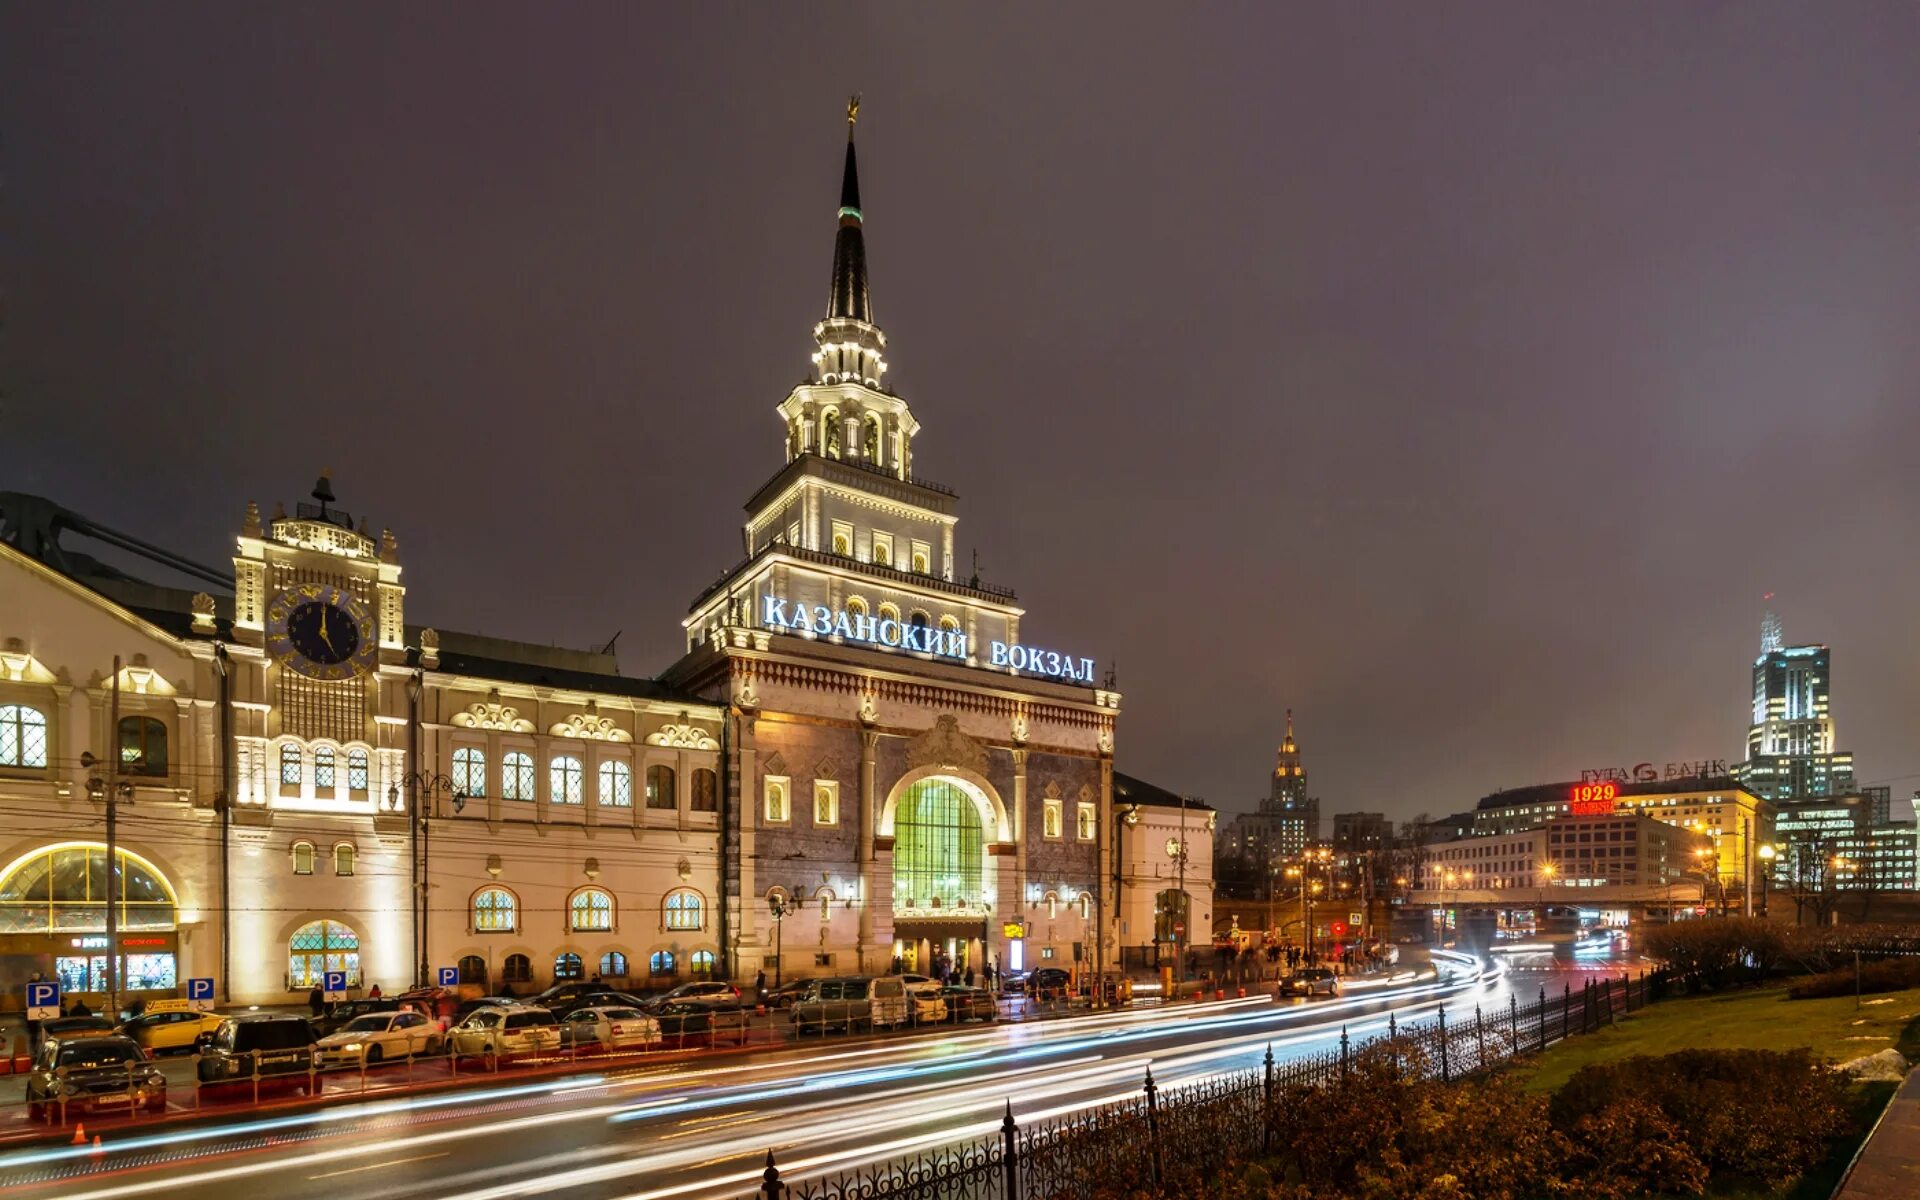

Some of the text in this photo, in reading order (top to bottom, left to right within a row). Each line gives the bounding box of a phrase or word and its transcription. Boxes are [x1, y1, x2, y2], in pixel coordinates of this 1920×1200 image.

[762, 595, 1094, 683] КАЗАНСКИЙ ВОКЗАЛ
[1581, 767, 1630, 782] ГУТА
[1664, 759, 1726, 777] БАНК
[1573, 783, 1615, 803] 1929
[329, 973, 342, 990] P
[443, 969, 455, 985] P
[35, 985, 53, 1005] P
[194, 981, 209, 998] P
